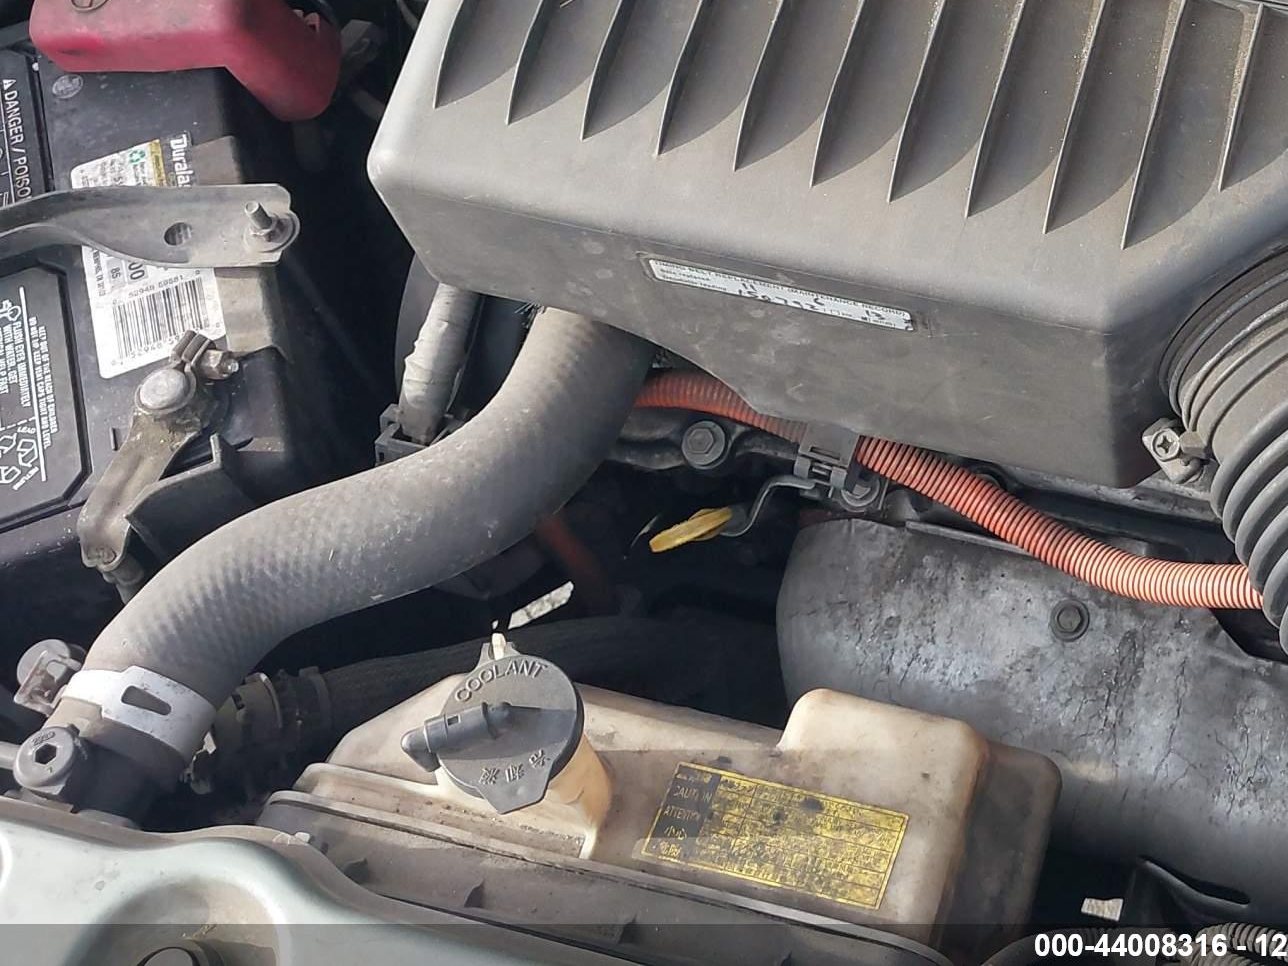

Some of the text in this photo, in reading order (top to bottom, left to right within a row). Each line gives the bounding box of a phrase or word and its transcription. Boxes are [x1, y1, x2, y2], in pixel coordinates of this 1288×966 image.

[3, 90, 25, 144] DANGER
[13, 156, 33, 202] POISO
[110, 266, 121, 279] 85
[3, 323, 14, 344] WITH
[12, 320, 31, 408] FLUSH EYES IMMEDIATELY
[33, 350, 42, 365] KEEP
[8, 369, 18, 384] GET
[35, 365, 44, 381] VENT
[0, 376, 9, 394] FAST
[36, 381, 46, 398] CAPS
[44, 374, 54, 394] REACH
[46, 394, 55, 403] OF
[17, 426, 36, 435] LEAD
[40, 416, 50, 430] AND
[42, 429, 52, 450] LEVEL
[12, 466, 40, 491] RETURN
[454, 659, 548, 703] COOLANT
